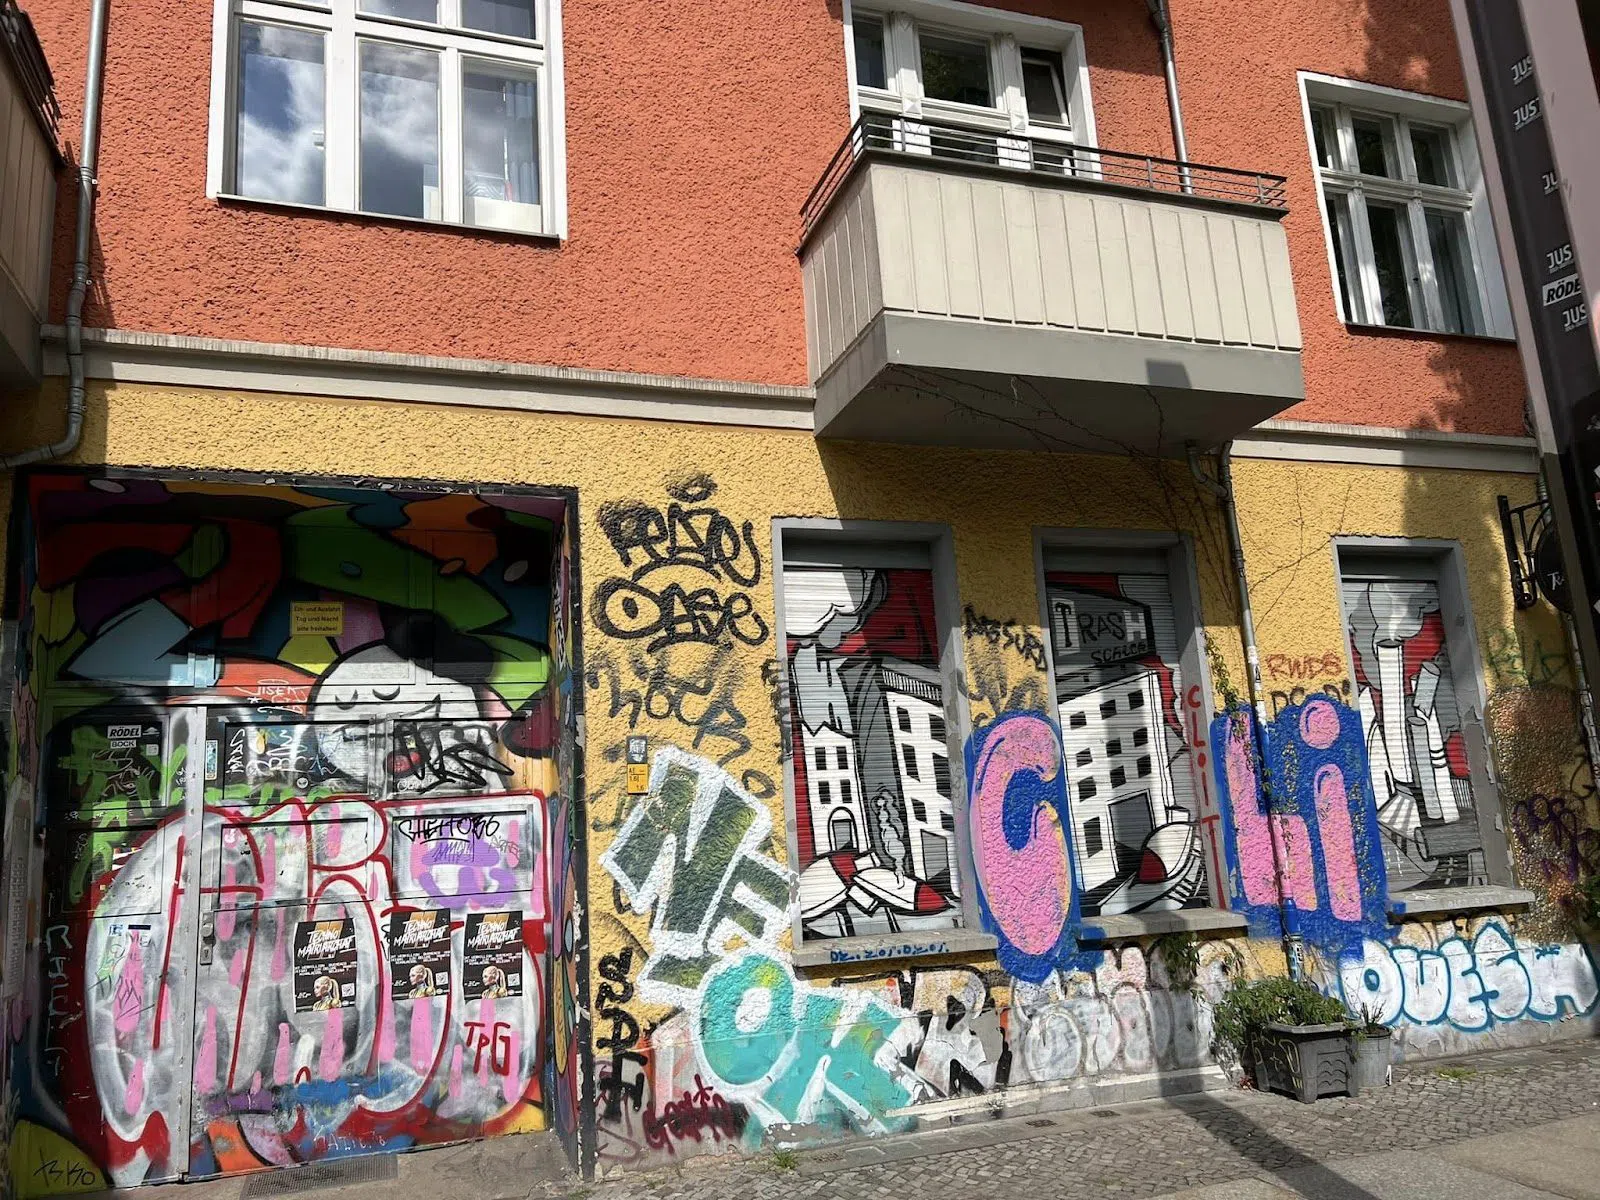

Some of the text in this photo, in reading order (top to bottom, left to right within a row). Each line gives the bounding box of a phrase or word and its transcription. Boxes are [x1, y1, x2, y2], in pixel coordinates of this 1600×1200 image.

[1054, 600, 1147, 648] TRASH
[109, 726, 141, 737] RÖDEL
[111, 739, 136, 748] BOCK
[403, 919, 433, 933] TECHNO
[476, 921, 505, 935] TECHNO
[307, 928, 340, 943] TECHNO
[464, 1022, 511, 1076] TPG
